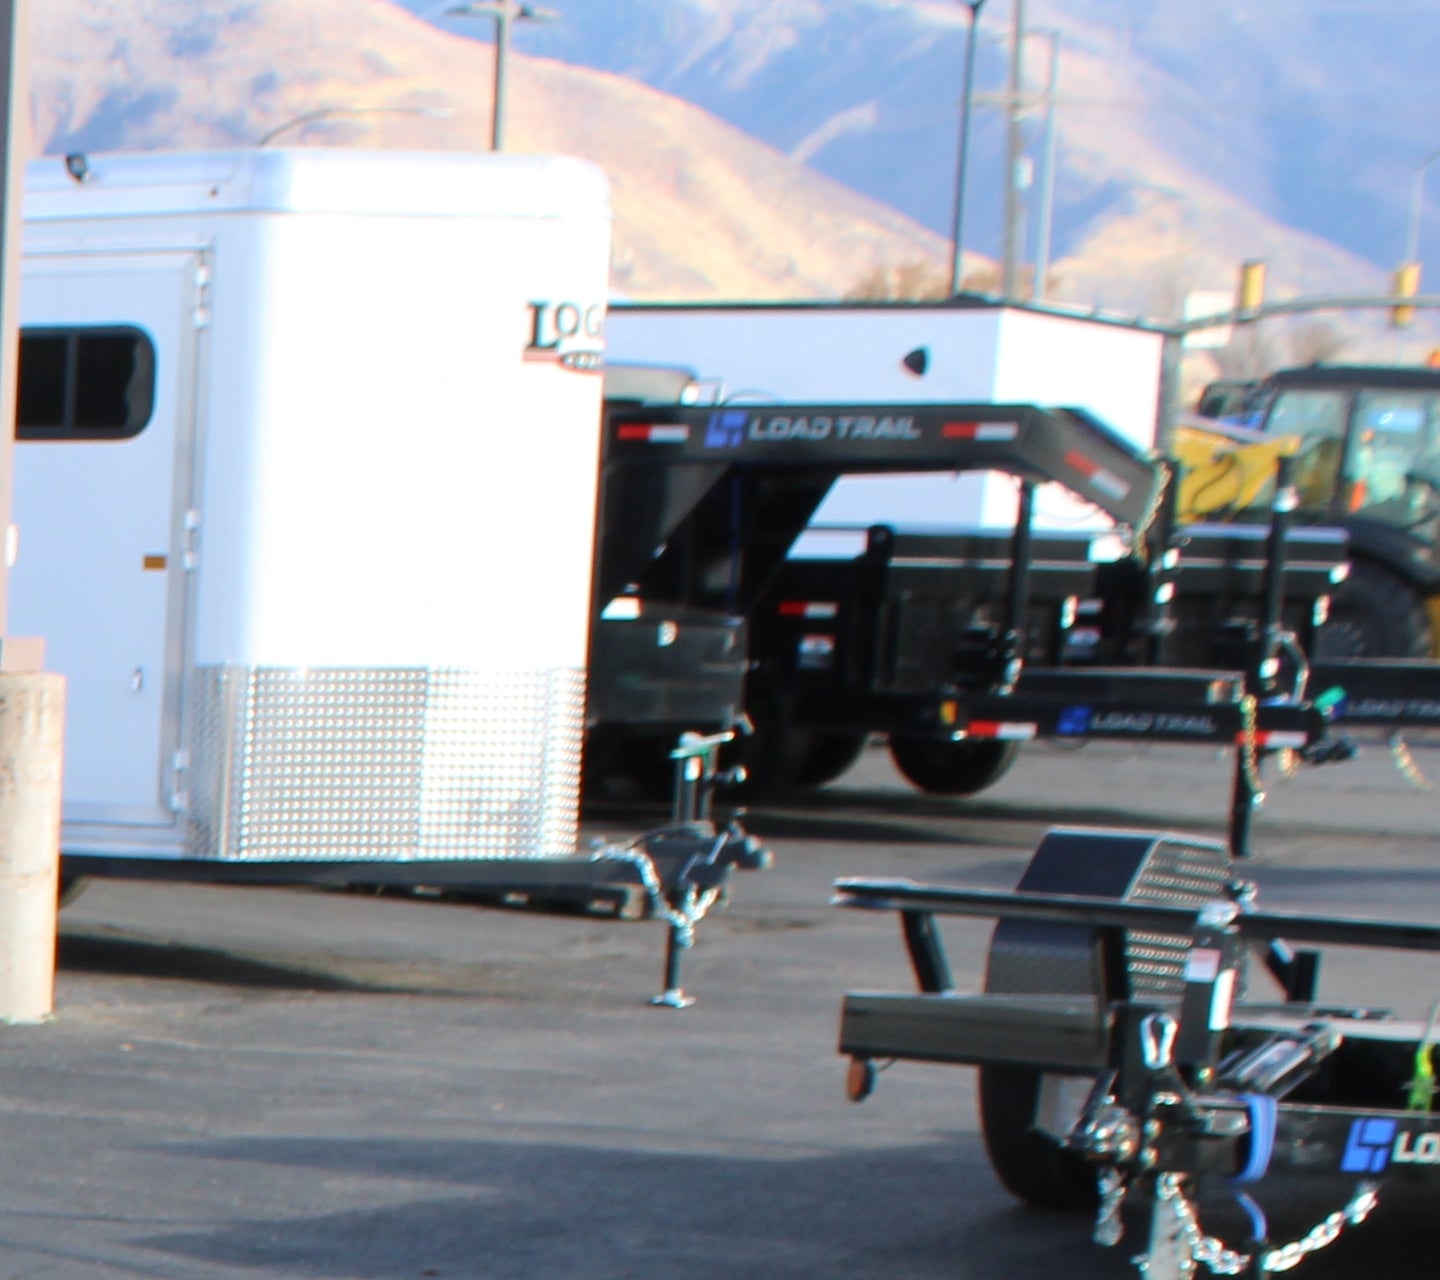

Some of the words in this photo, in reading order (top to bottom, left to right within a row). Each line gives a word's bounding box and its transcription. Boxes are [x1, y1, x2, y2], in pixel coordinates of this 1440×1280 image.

[747, 416, 831, 440] LOAD
[835, 416, 923, 439] TRAIL
[1391, 1131, 1440, 1164] LO
